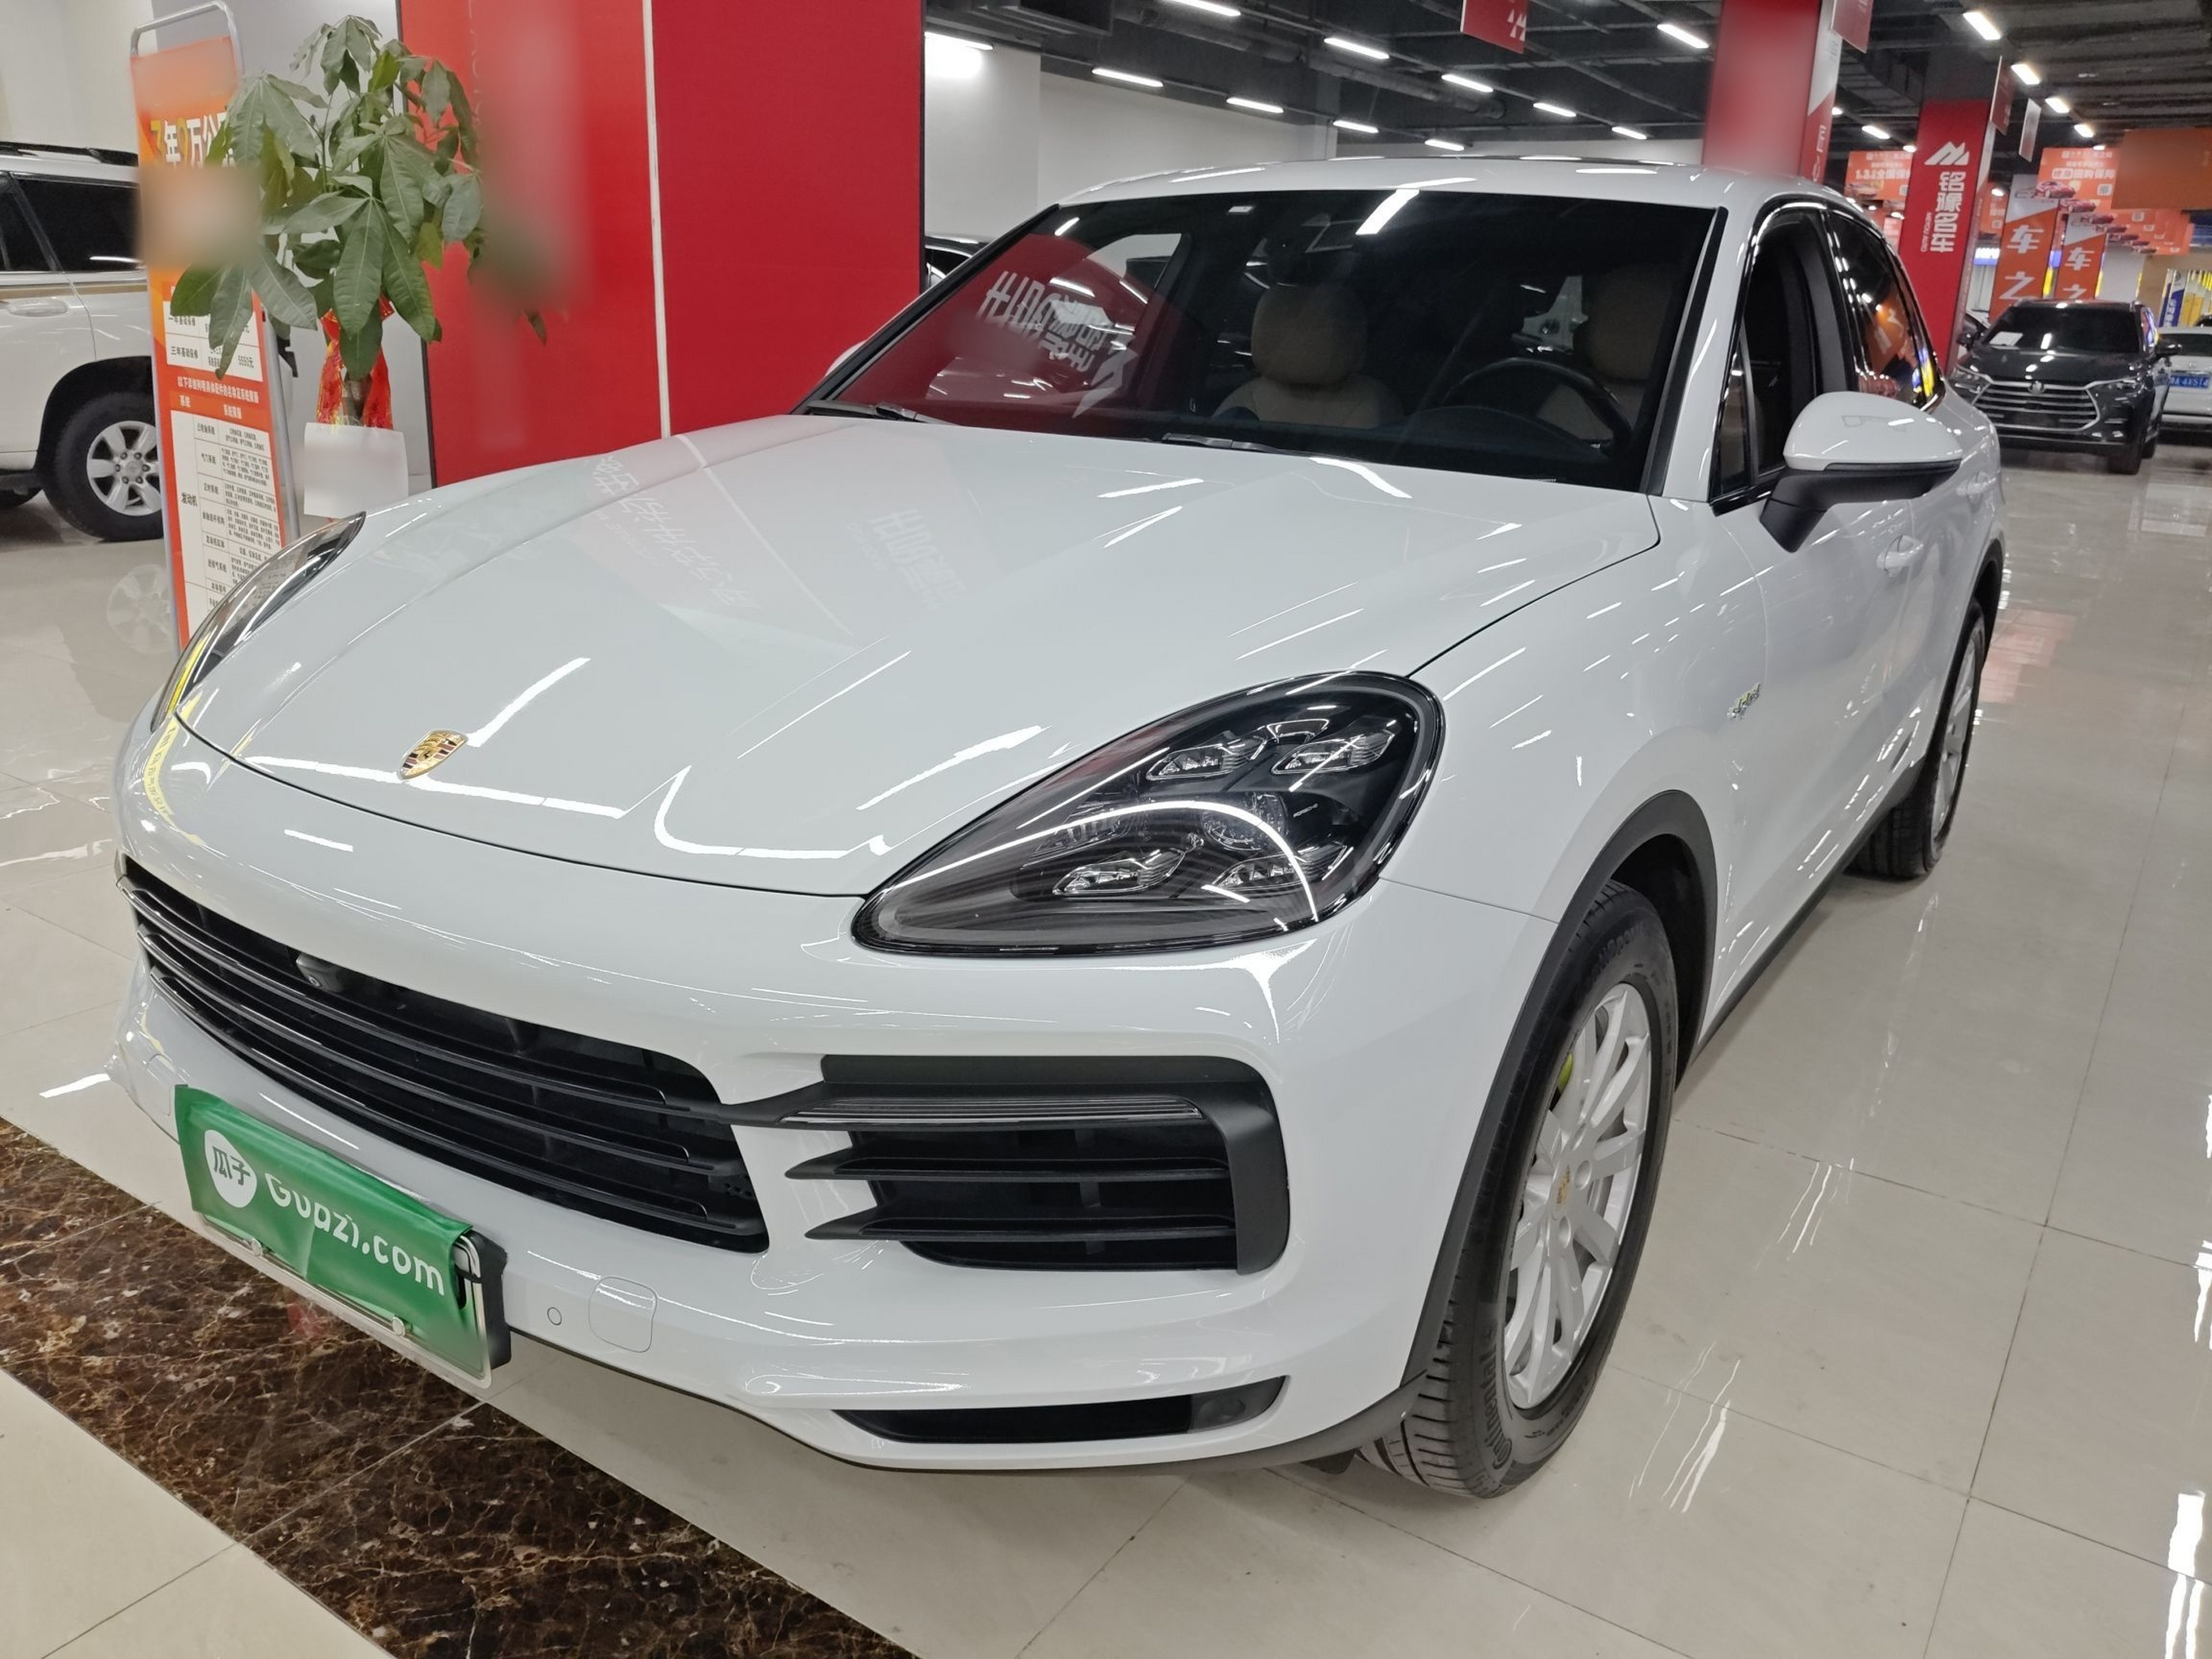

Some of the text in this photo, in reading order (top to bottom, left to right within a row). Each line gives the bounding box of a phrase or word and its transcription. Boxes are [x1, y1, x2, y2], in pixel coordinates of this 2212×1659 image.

[181, 492, 198, 507] 发动机
[212, 1145, 252, 1186] 瓜子
[264, 1172, 446, 1297] Guazi.com
